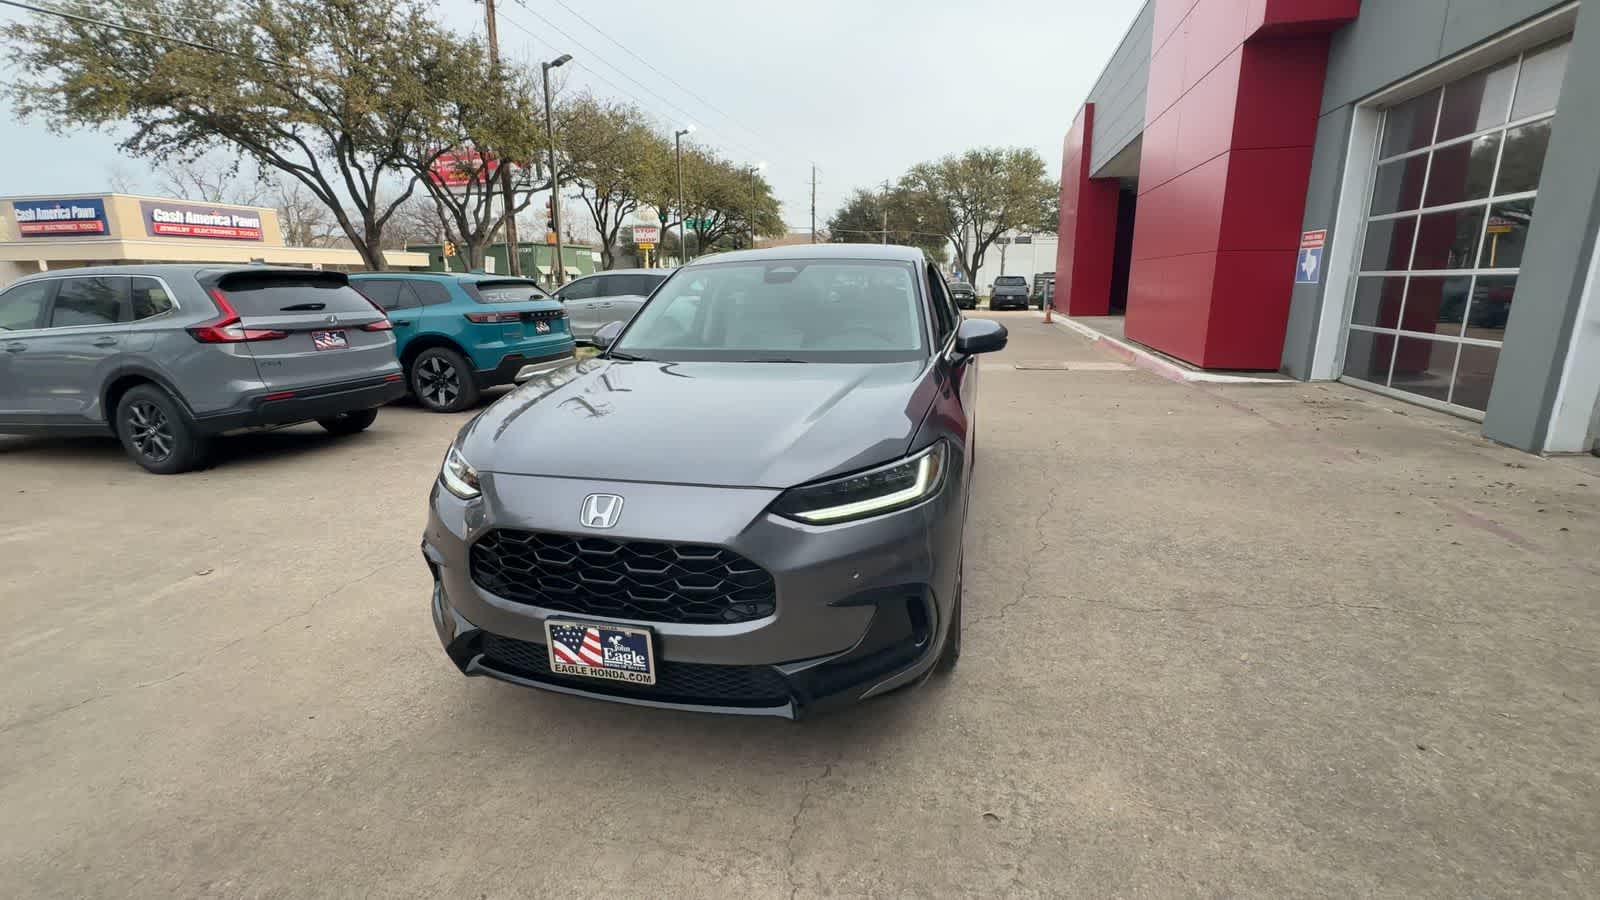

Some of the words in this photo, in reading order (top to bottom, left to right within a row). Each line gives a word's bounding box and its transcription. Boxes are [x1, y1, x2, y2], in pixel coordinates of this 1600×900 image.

[15, 208, 36, 221] Cash
[36, 205, 71, 220] America
[71, 206, 96, 219] Pawn
[153, 208, 184, 223] Cash
[185, 210, 231, 226] America
[231, 214, 260, 228] Pawn
[193, 227, 237, 236] ELECTRONICS
[614, 643, 631, 652] John
[603, 647, 646, 666] Eagle
[555, 664, 588, 675] EAGLE
[590, 667, 652, 683] HONDA.COM
